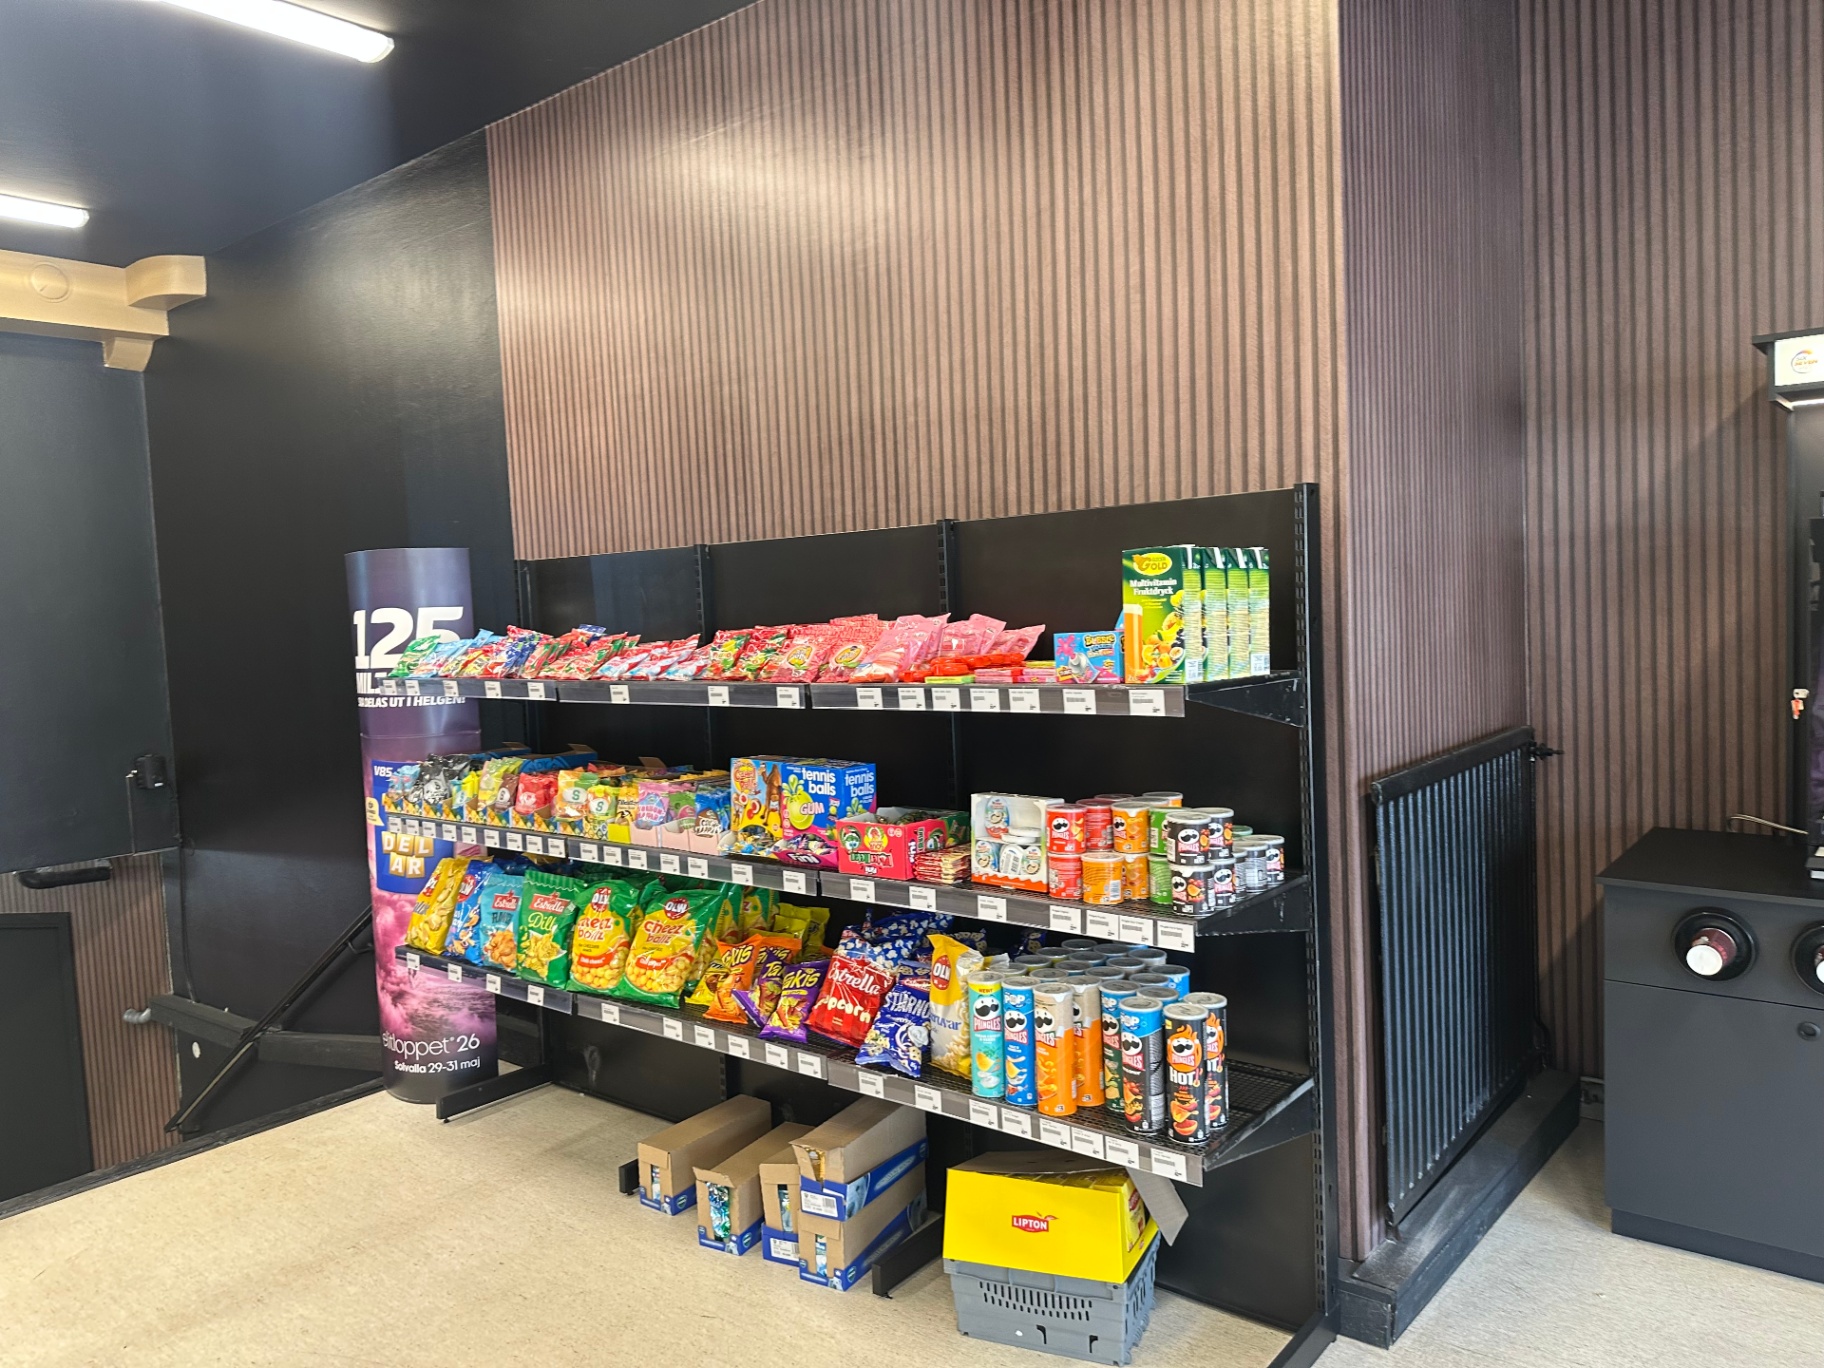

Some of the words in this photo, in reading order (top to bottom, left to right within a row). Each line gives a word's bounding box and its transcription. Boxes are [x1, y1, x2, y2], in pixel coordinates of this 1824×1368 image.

[1141, 562, 1168, 571] GOLD
[1129, 578, 1177, 587] Multivitamin
[1133, 586, 1174, 596] Fruktdryck
[353, 606, 464, 669] 125
[389, 697, 405, 707] UT
[406, 696, 412, 707] I
[374, 766, 393, 777] V85
[802, 768, 836, 783] tennis
[845, 770, 874, 786] tennis
[572, 789, 580, 801] S
[808, 782, 836, 796] balls
[850, 784, 875, 797] balls
[595, 801, 604, 812] S
[800, 802, 825, 815] GUM
[384, 835, 430, 854] DEL
[391, 858, 421, 874] AR
[534, 897, 565, 912] Estrella
[665, 904, 688, 914] OLW
[528, 912, 557, 931] Dill
[828, 961, 880, 995] Estrella
[974, 1017, 1001, 1031] PRINGLES
[394, 1060, 427, 1073] Solvalla
[428, 1060, 458, 1073] 29-31
[460, 1056, 481, 1069] maj
[1169, 1066, 1195, 1085] HOT
[1013, 1217, 1047, 1230] LIPTON
